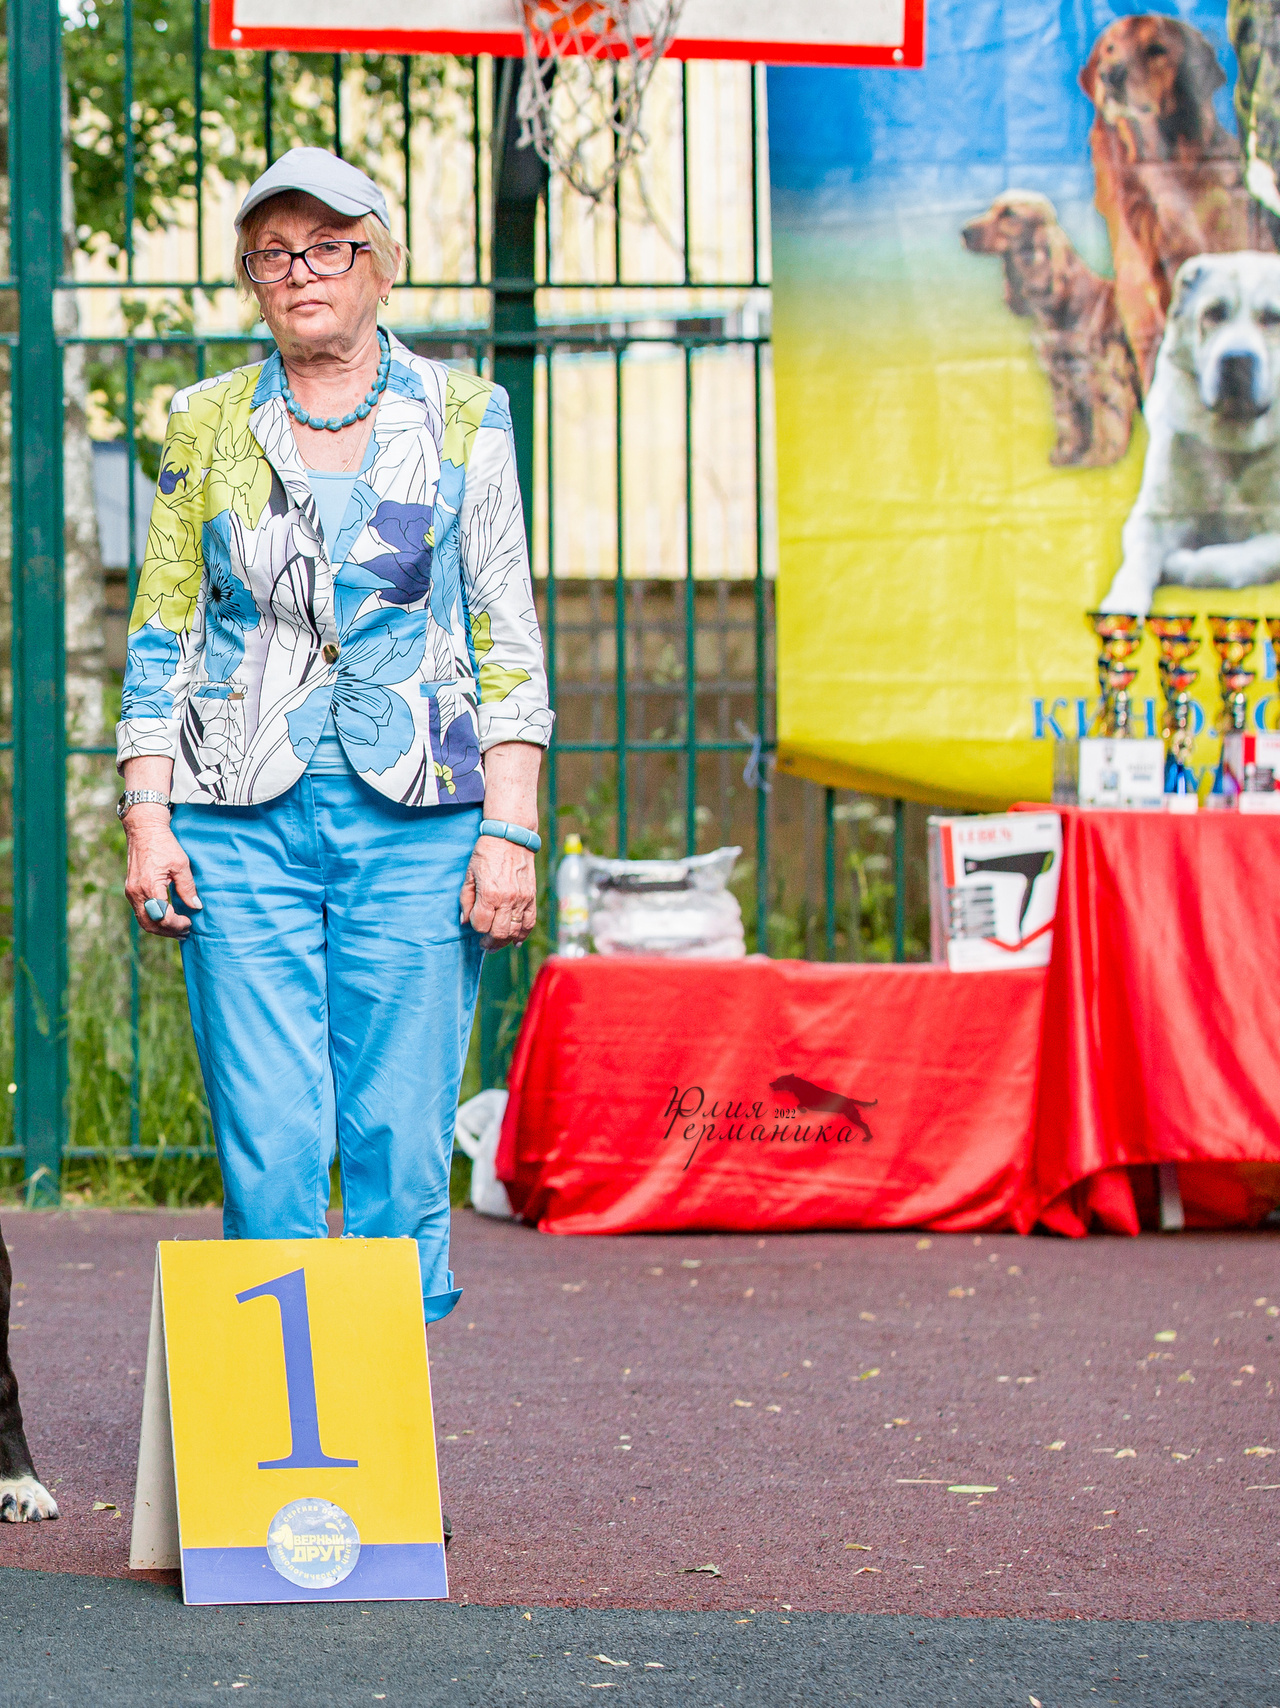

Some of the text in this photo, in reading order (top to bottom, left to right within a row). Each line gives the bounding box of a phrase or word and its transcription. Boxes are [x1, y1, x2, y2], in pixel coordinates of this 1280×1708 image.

[235, 1266, 359, 1470] 1
[283, 1506, 347, 1529] СЕРГИЕВ ПОСАД
[291, 1545, 344, 1562] ДРУГ
